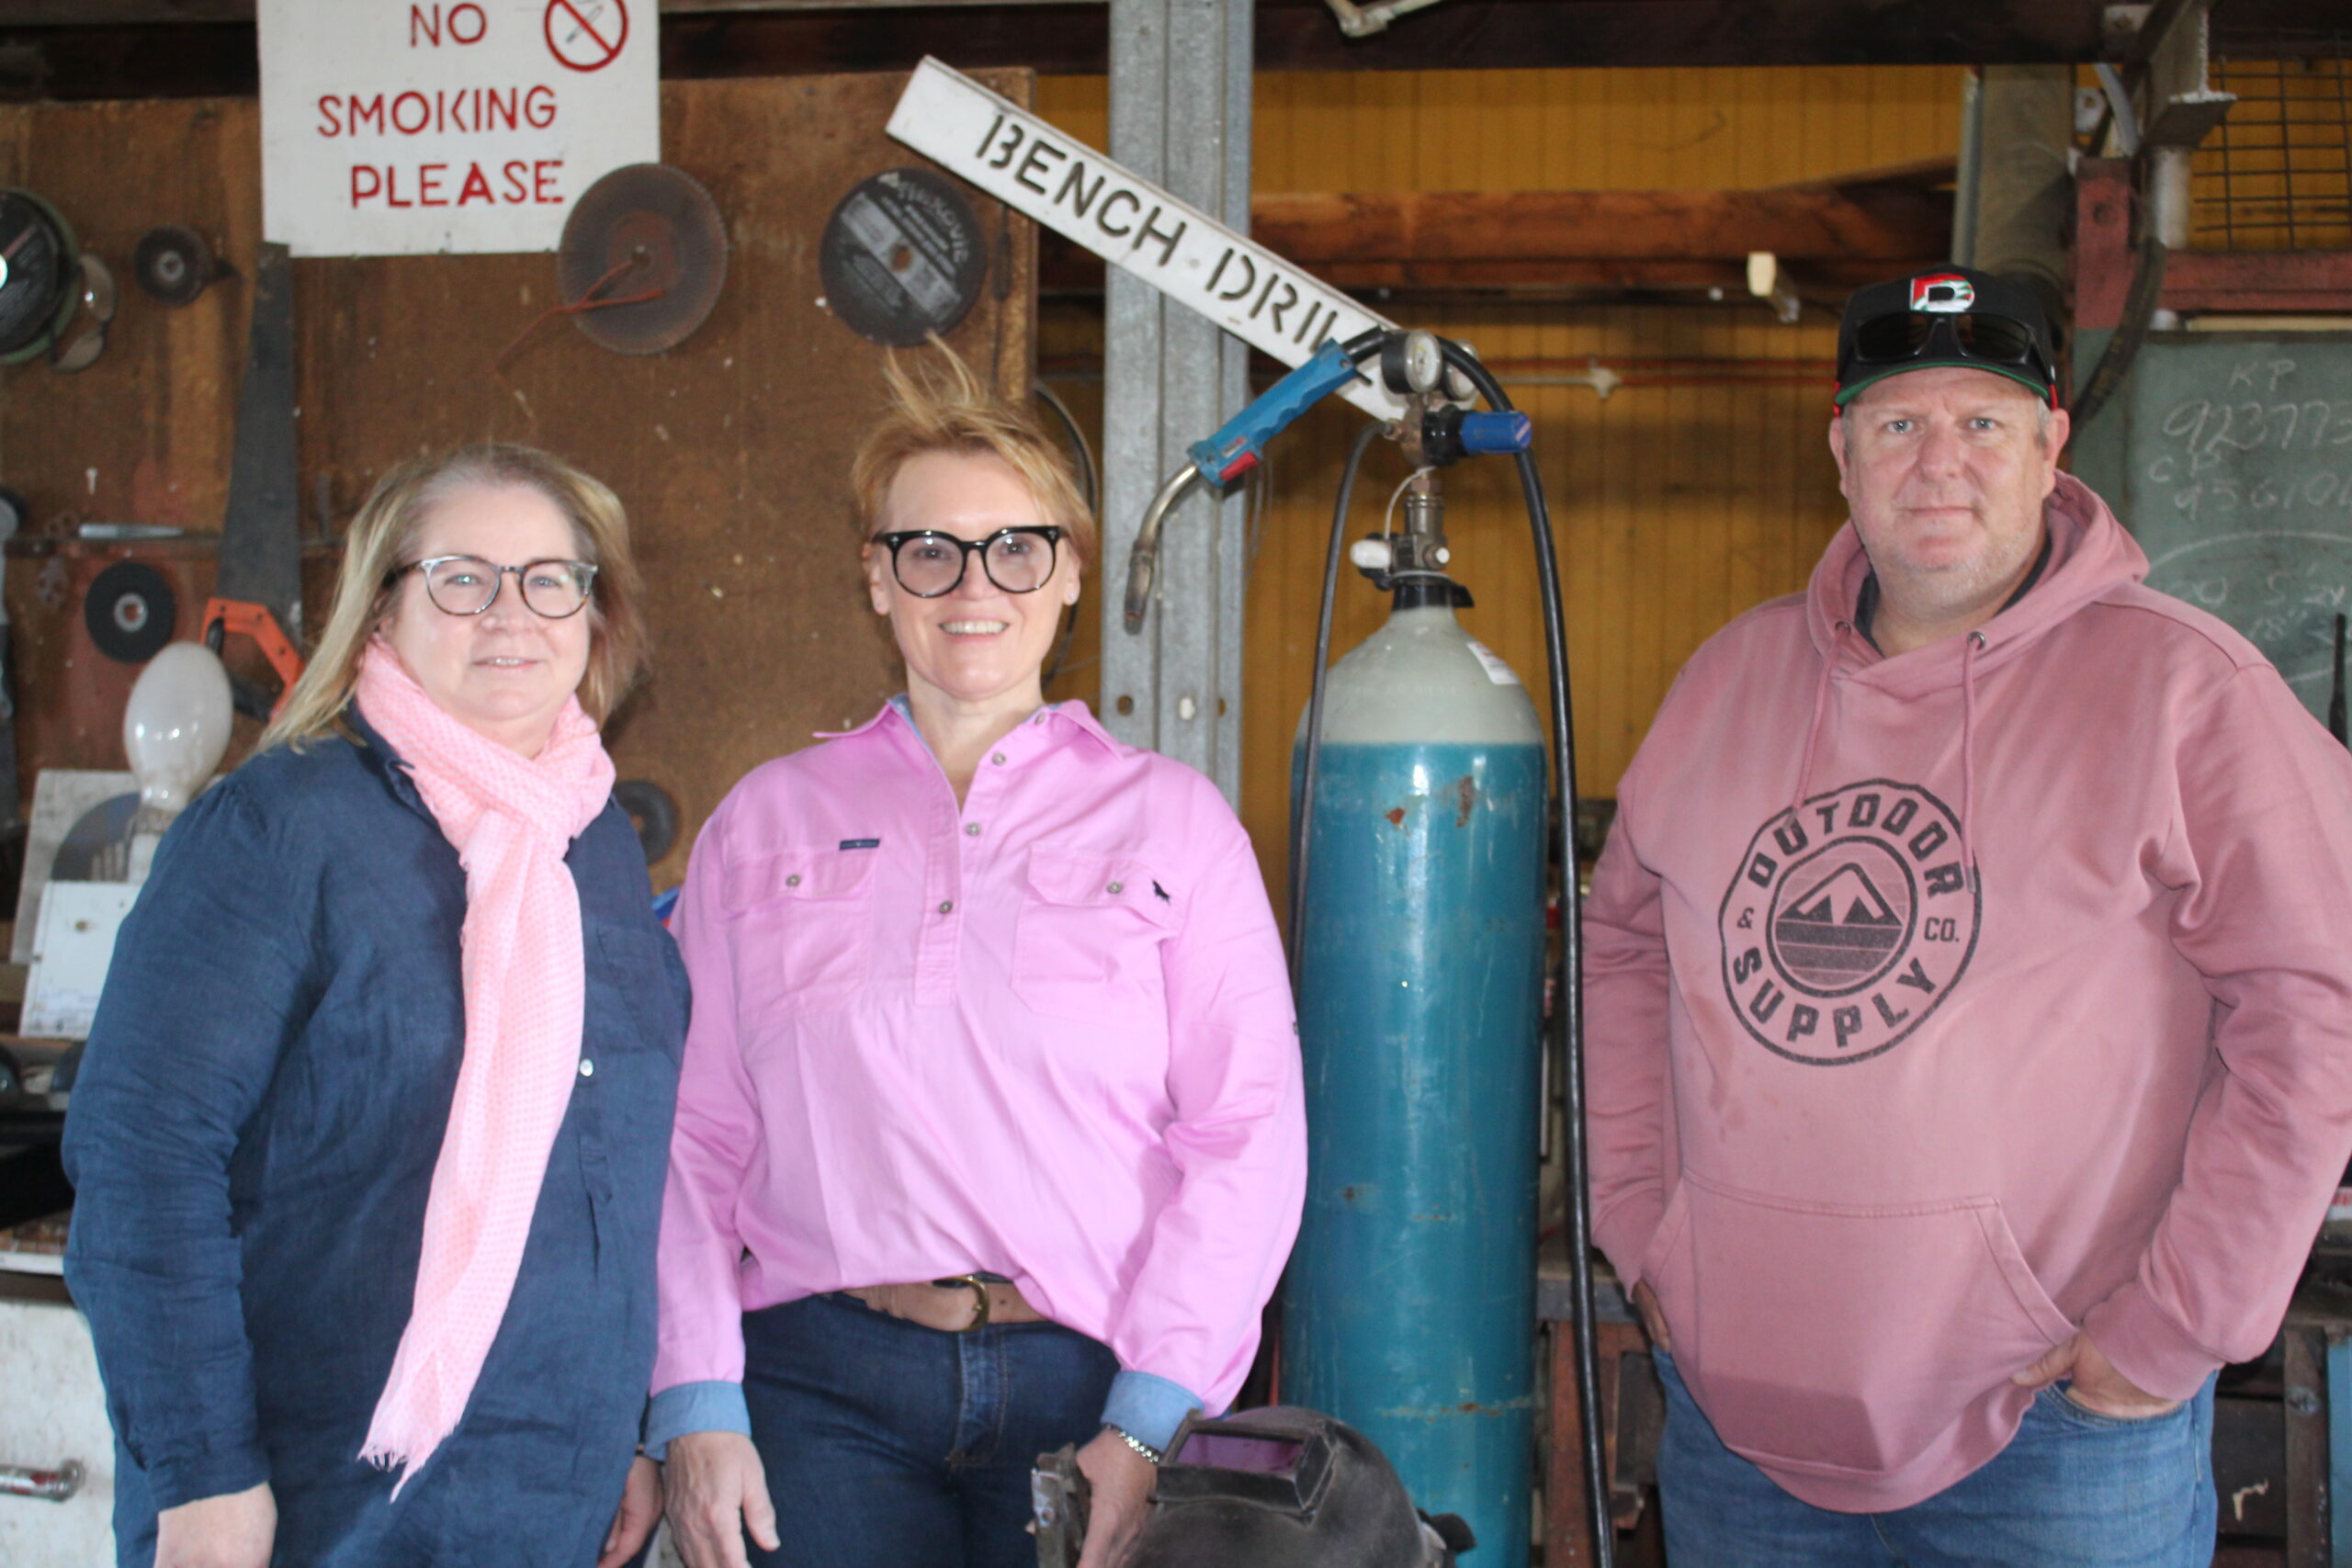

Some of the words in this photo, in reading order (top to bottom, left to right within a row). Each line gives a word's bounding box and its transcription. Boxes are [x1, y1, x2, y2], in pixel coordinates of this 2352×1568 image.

[411, 4, 487, 47] NO
[317, 85, 558, 138] SMOKING
[351, 160, 564, 209] PLEASE
[975, 115, 1187, 267] BENCH
[1747, 794, 1964, 898] OUTDOOR
[1736, 907, 1755, 931] &
[1924, 917, 1960, 942] CO.
[1734, 947, 1936, 1048] SUPPLY
